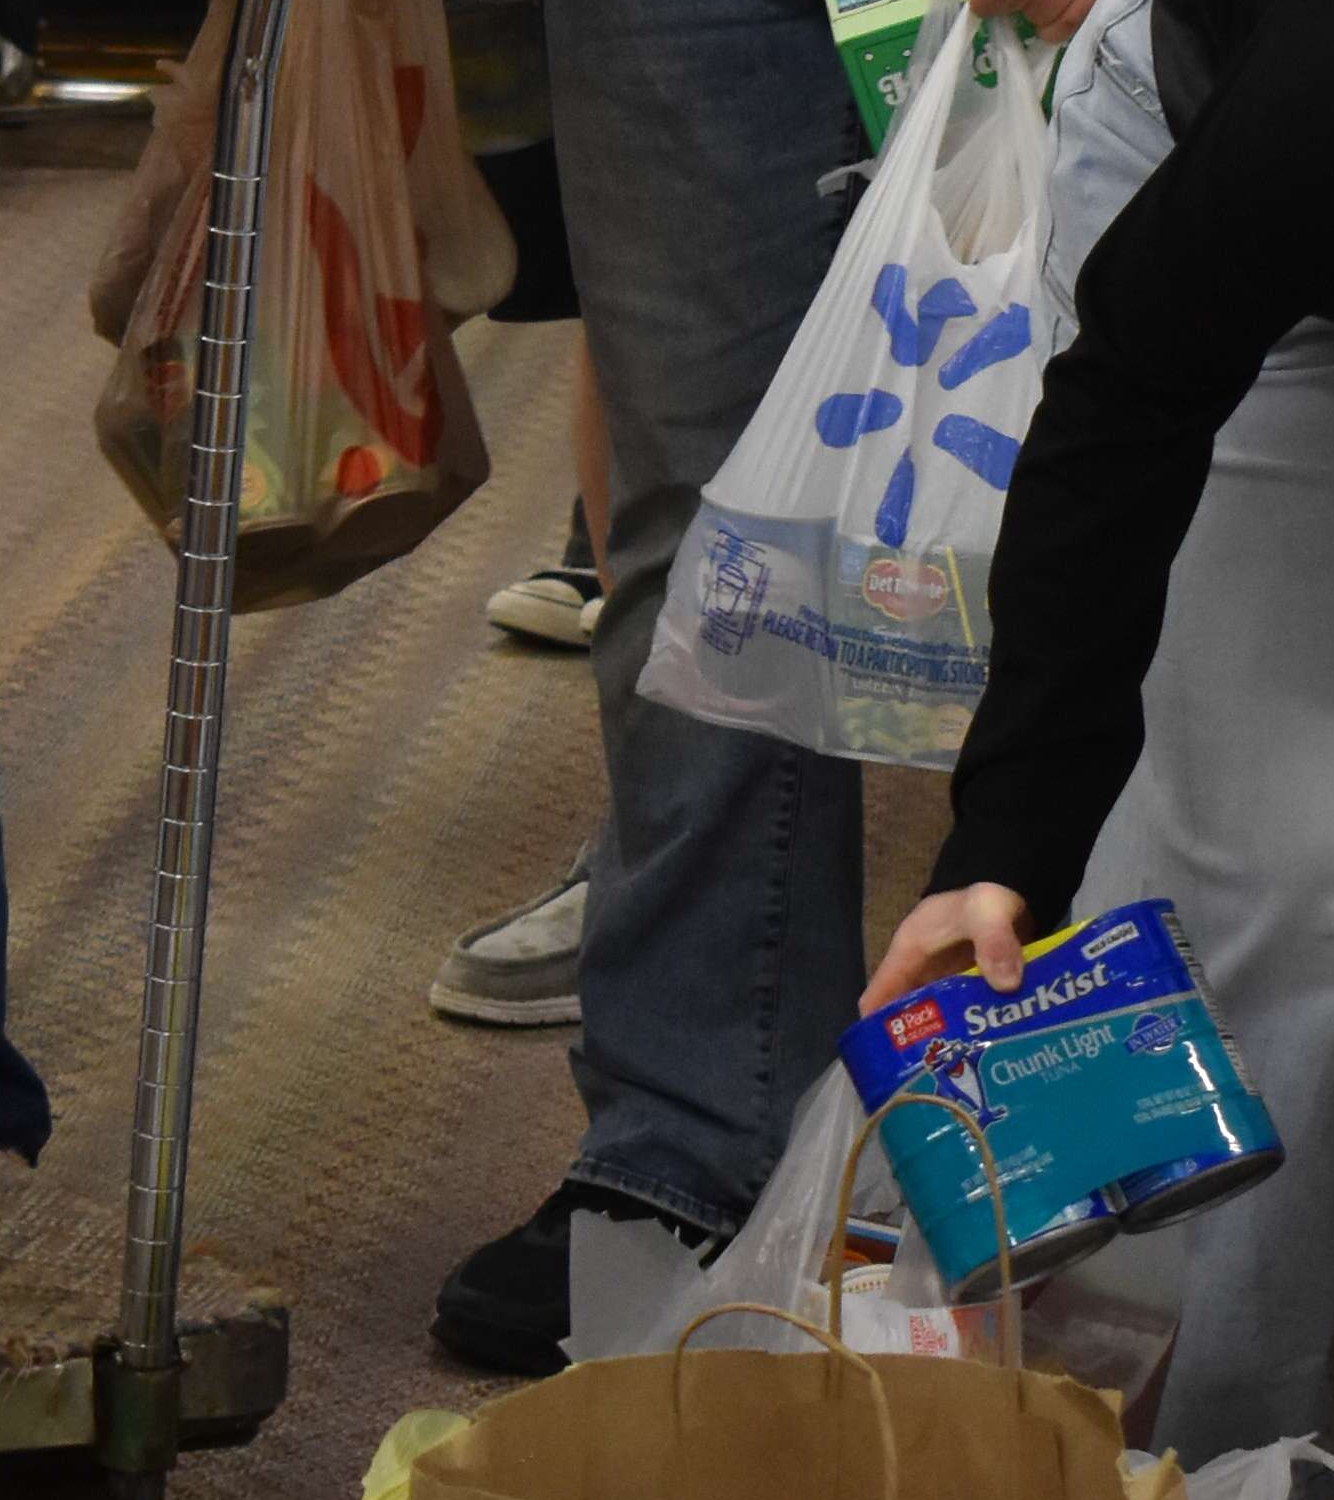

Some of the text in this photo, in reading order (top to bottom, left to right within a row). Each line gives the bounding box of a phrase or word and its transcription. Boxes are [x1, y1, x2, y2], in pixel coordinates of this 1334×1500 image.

[890, 1014, 905, 1035] 8
[904, 1005, 934, 1031] Pack
[964, 962, 1110, 1036] StarKist
[990, 1022, 1116, 1087] Chunk Light
